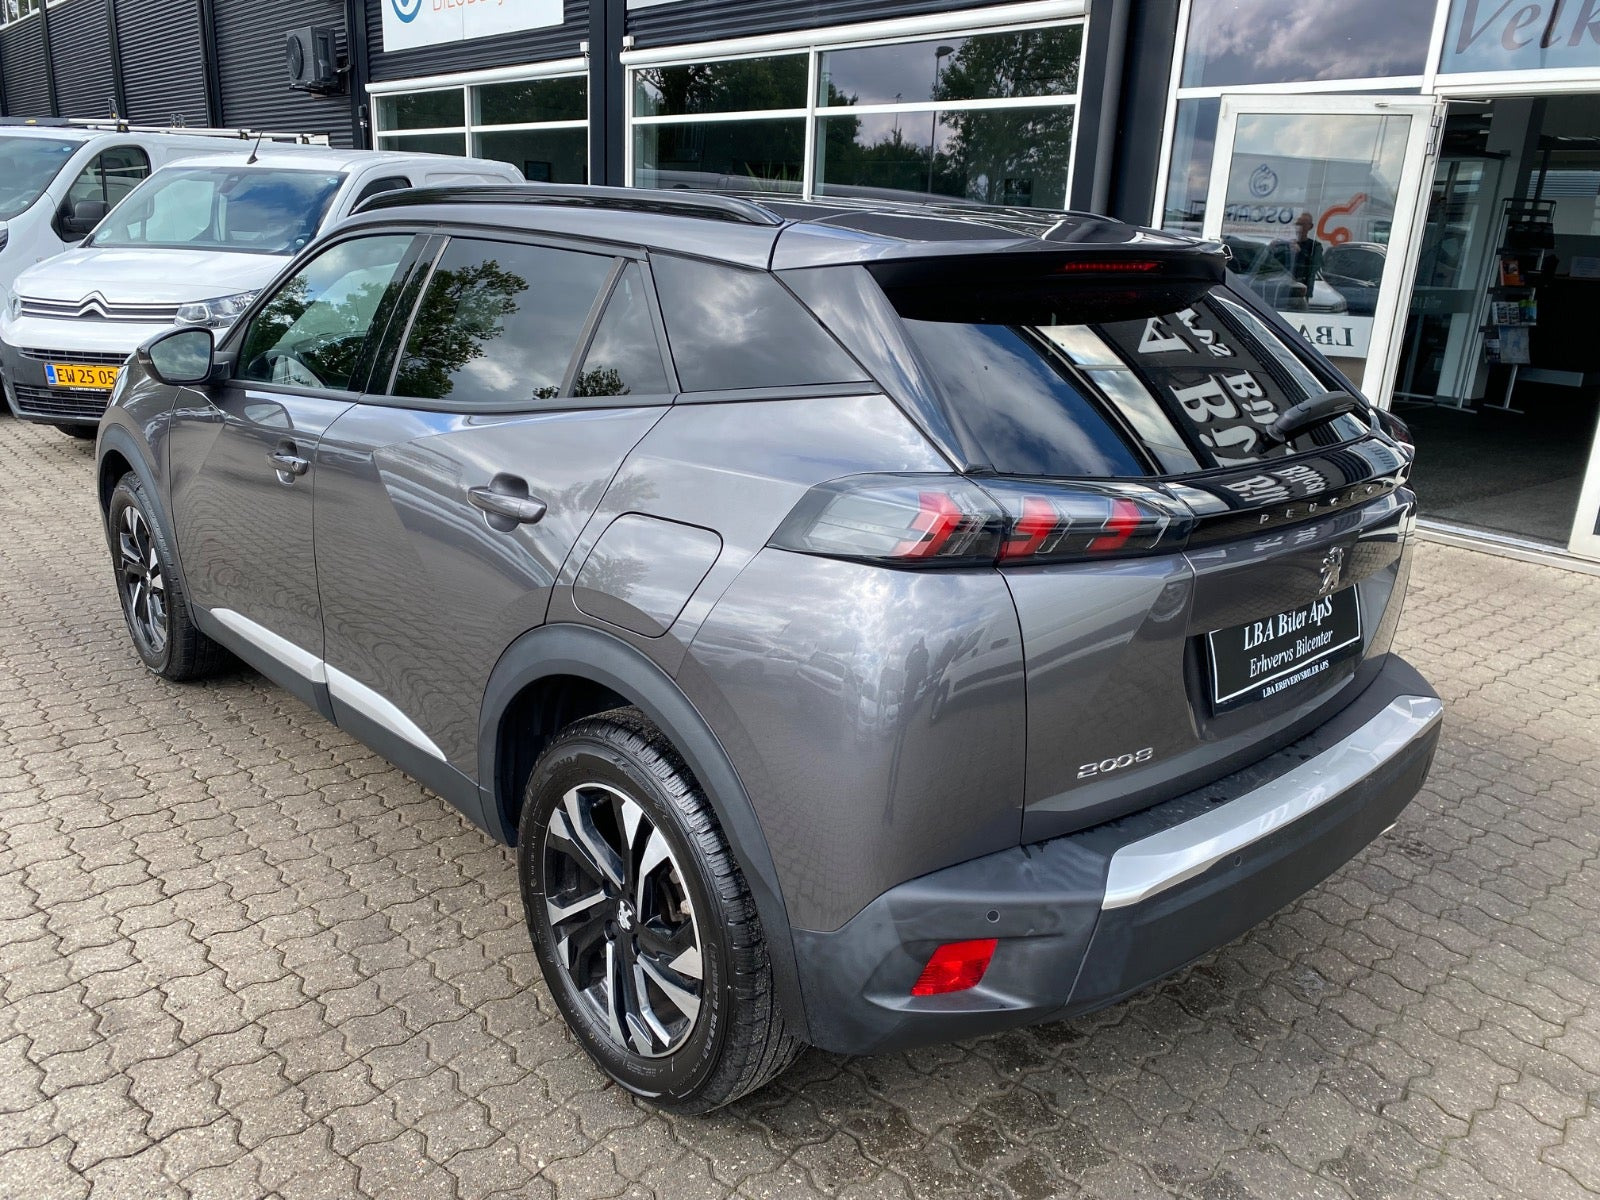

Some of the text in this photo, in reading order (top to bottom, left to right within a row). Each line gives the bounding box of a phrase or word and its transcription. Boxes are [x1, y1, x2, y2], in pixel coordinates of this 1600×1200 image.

[56, 368, 118, 385] EW 25 05
[1243, 594, 1333, 650] LBA Biler ApS
[1250, 630, 1334, 678] Erhvervs Bilcenter
[1262, 659, 1330, 698] LBA ERHVERVSBILER APS
[1077, 747, 1153, 779] 2008
